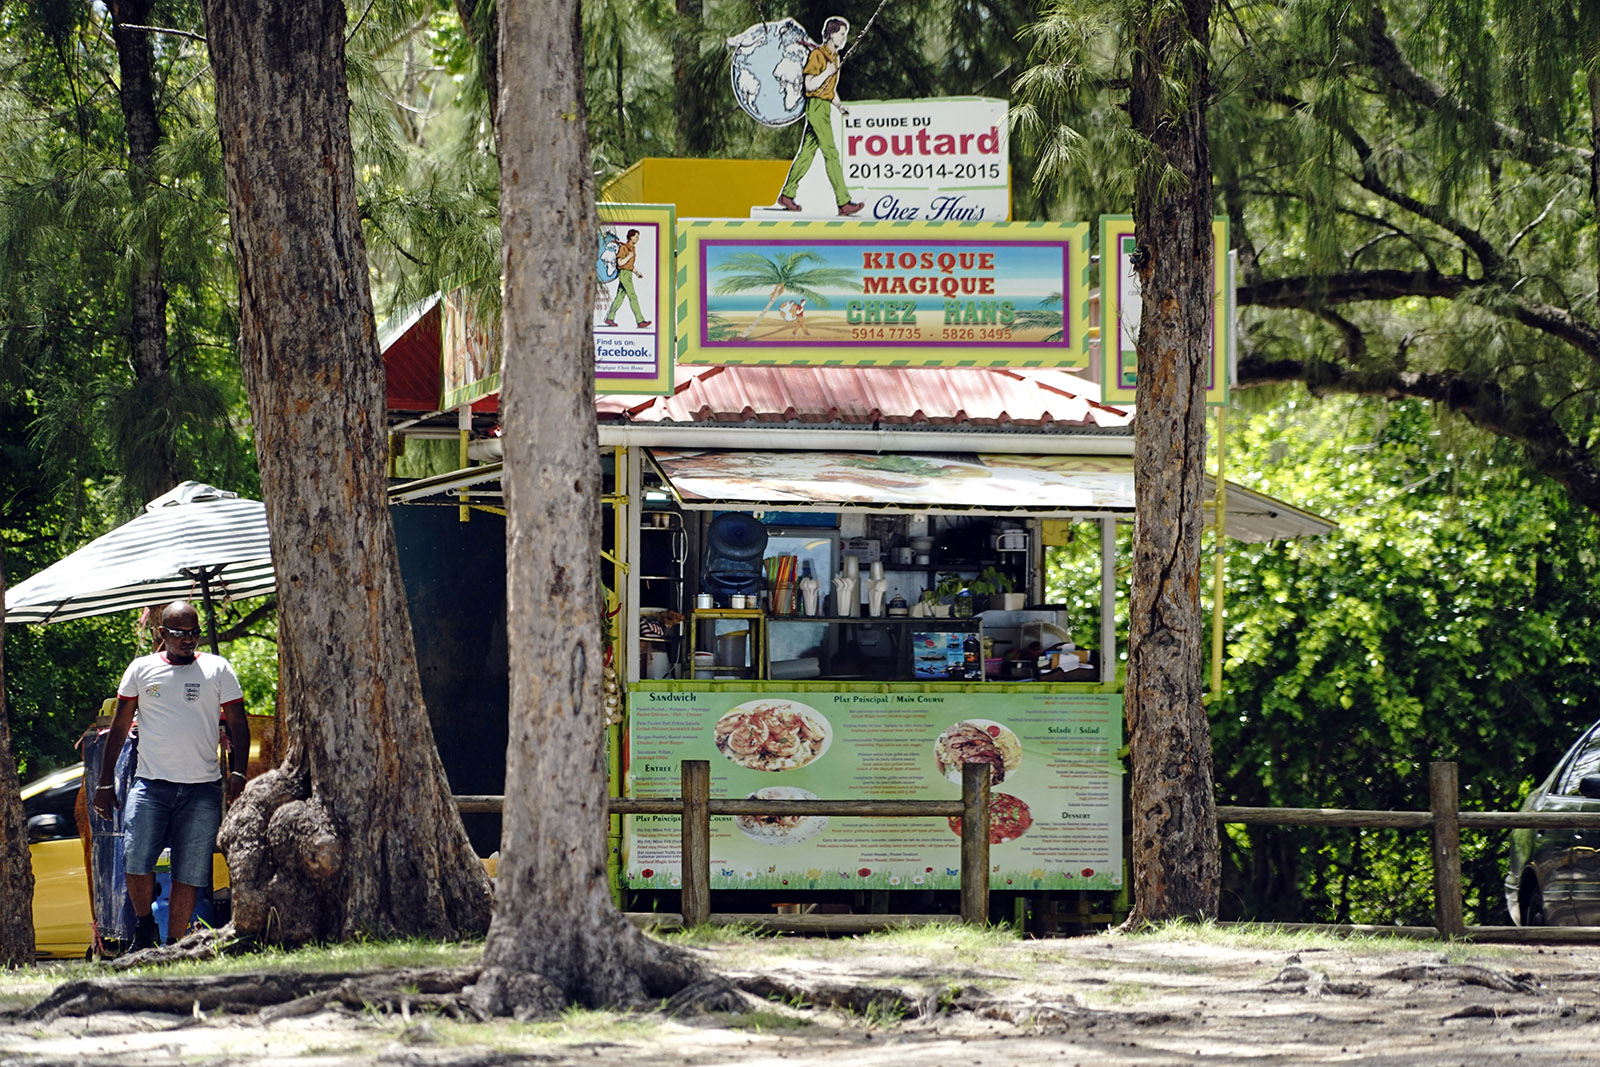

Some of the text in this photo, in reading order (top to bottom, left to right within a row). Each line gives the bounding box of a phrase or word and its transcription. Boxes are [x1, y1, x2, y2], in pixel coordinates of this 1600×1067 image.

[846, 117, 931, 128] LE GUIDE DU
[848, 126, 999, 156] routard
[849, 164, 1000, 178] 2013-2014-2015
[873, 195, 985, 221] Chez Han's
[862, 252, 995, 274] KIOSQUE
[862, 277, 995, 298] MAGIQUE
[846, 300, 1016, 325] CHEZ HANS
[852, 328, 884, 340] 5914
[888, 328, 922, 340] 7735
[942, 328, 974, 340] 5826
[979, 328, 1012, 340] 3495
[597, 346, 648, 357] facebook
